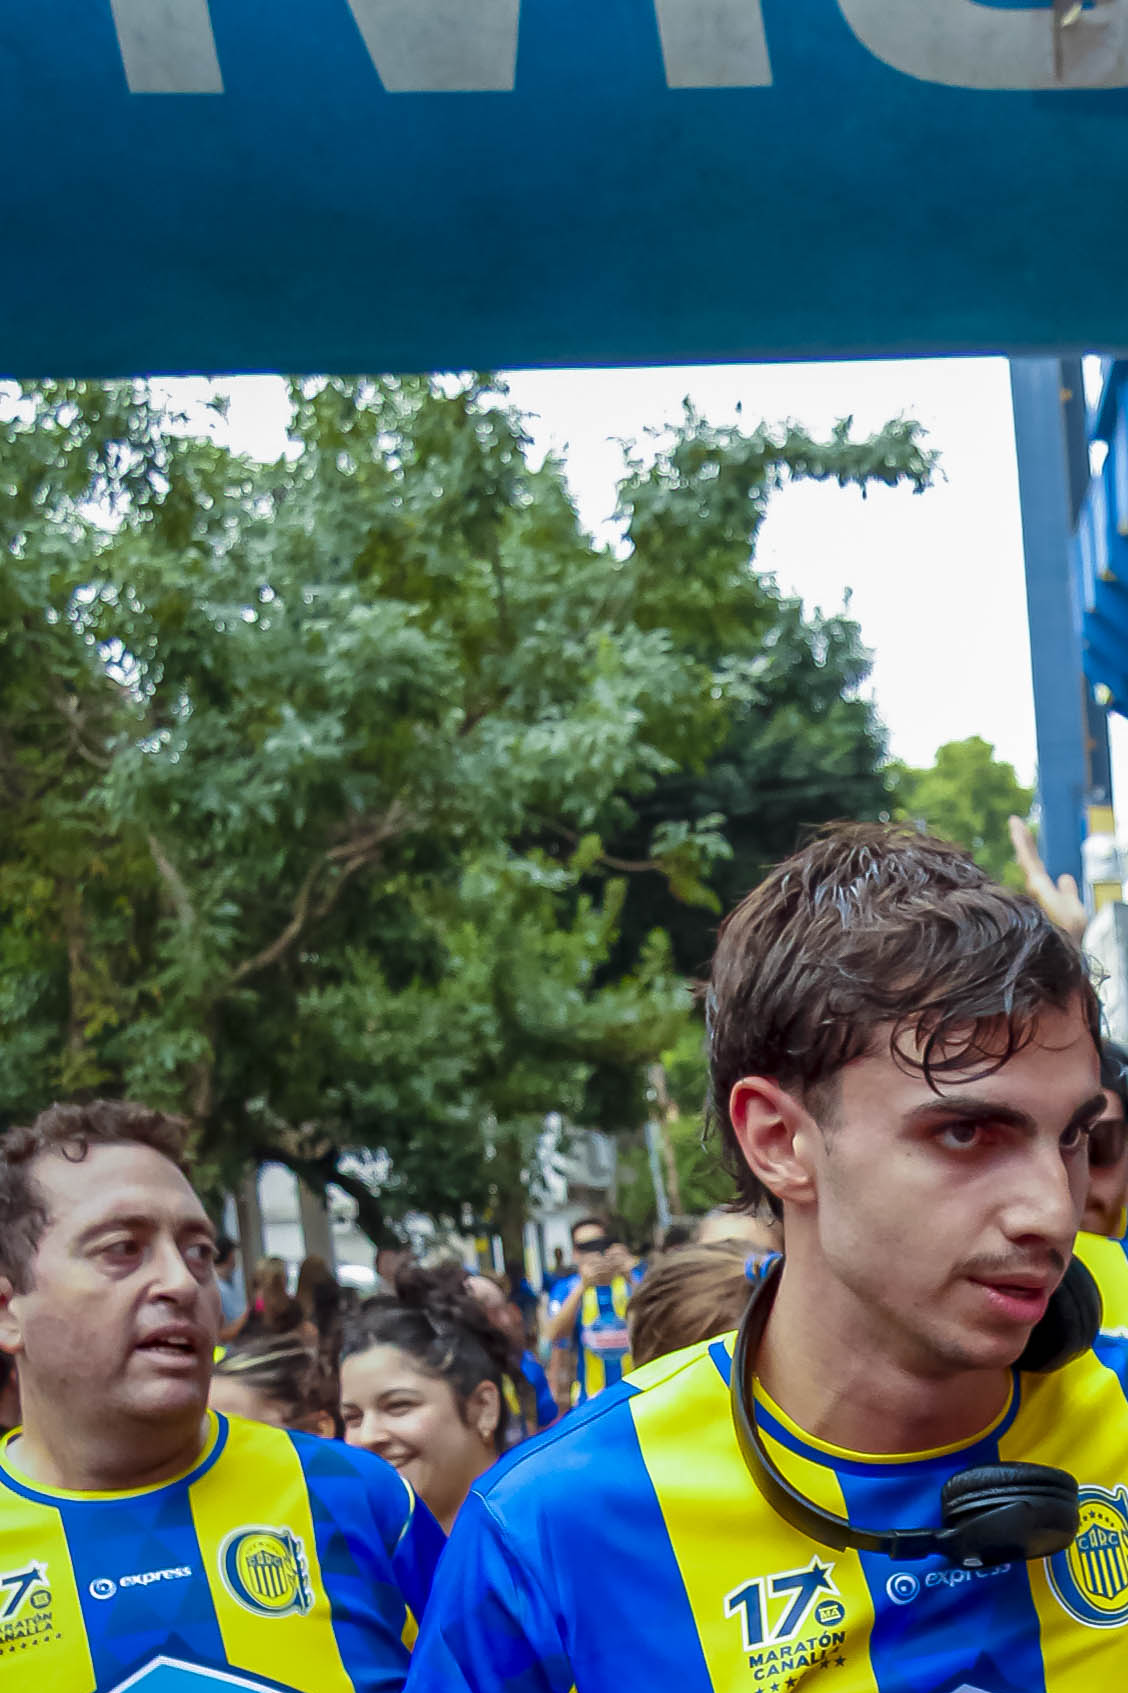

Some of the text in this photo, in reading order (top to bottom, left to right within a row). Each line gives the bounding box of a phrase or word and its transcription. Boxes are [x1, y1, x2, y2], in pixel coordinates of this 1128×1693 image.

[0, 1562, 49, 1619] 7
[725, 1556, 839, 1651] 17
[749, 1626, 846, 1668] MARATÓN
[754, 1641, 840, 1681] CANALL
